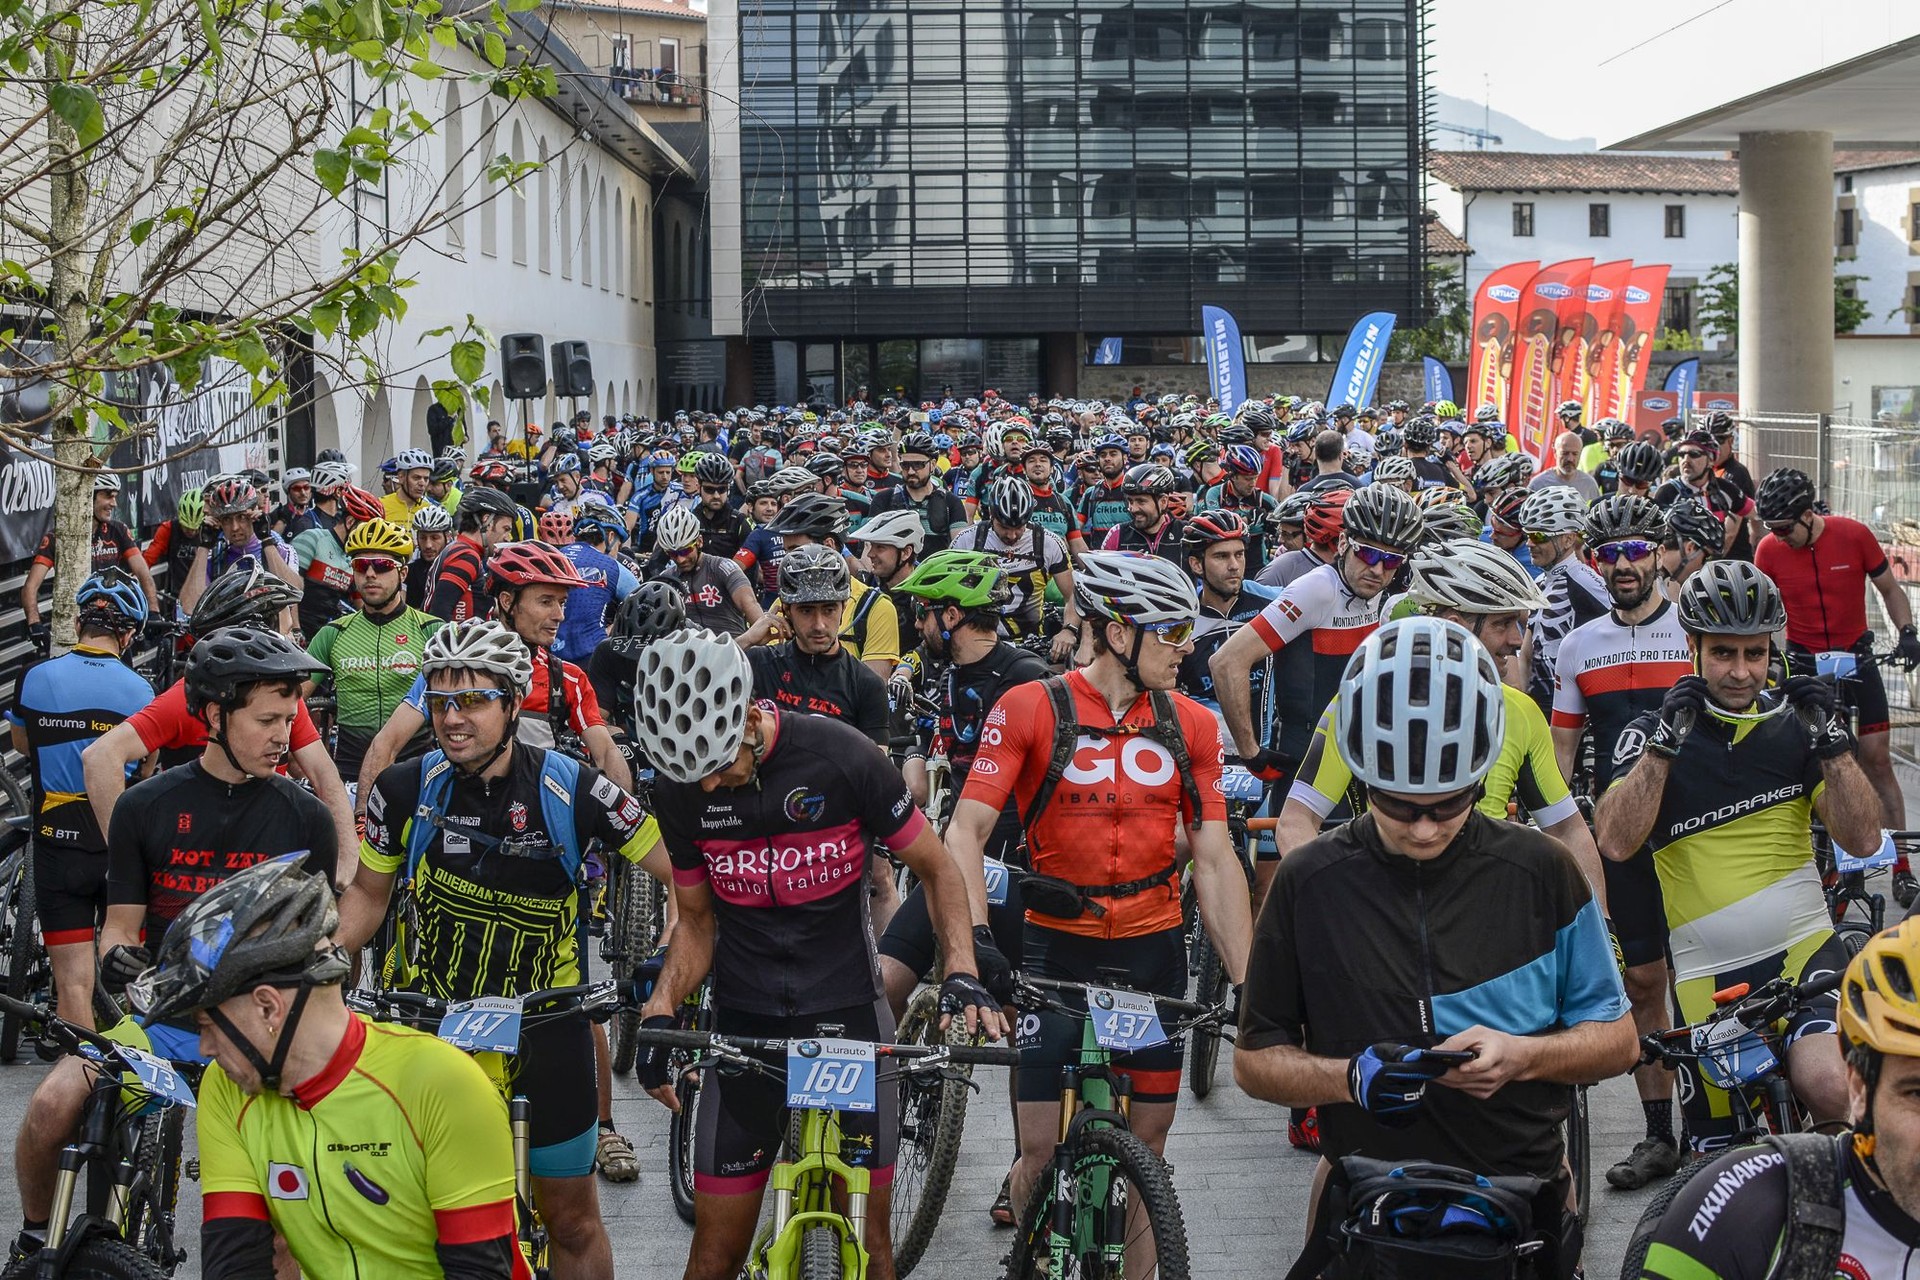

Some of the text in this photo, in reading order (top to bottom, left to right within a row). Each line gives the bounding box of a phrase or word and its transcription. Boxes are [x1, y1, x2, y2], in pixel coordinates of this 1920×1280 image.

[1537, 284, 1573, 299] ARTIACH
[1214, 317, 1232, 412] MICHELIN
[1344, 322, 1380, 408] ICHELIN
[1643, 399, 1672, 410] ARTIACH
[1584, 648, 1689, 671] MONTADITOS PRO TEAM
[38, 715, 117, 733] durruma kan
[980, 726, 1002, 746] GO
[974, 760, 995, 772] KIA
[1061, 734, 1176, 787] GO
[1221, 774, 1248, 792] 214
[1670, 782, 1804, 837] MONDRAKER
[701, 816, 743, 831] happytalde
[55, 828, 80, 841] BTT
[786, 862, 853, 893] taldea
[477, 1001, 515, 1011] Lurauto
[1117, 999, 1149, 1013] Lurauto
[452, 1011, 511, 1038] 147
[1104, 1013, 1155, 1041] 437
[1710, 1026, 1738, 1043] Lurauto
[825, 1045, 868, 1057] Lurauto
[146, 1064, 176, 1091] 73
[802, 1060, 864, 1095] 160
[788, 1092, 810, 1105] BTT
